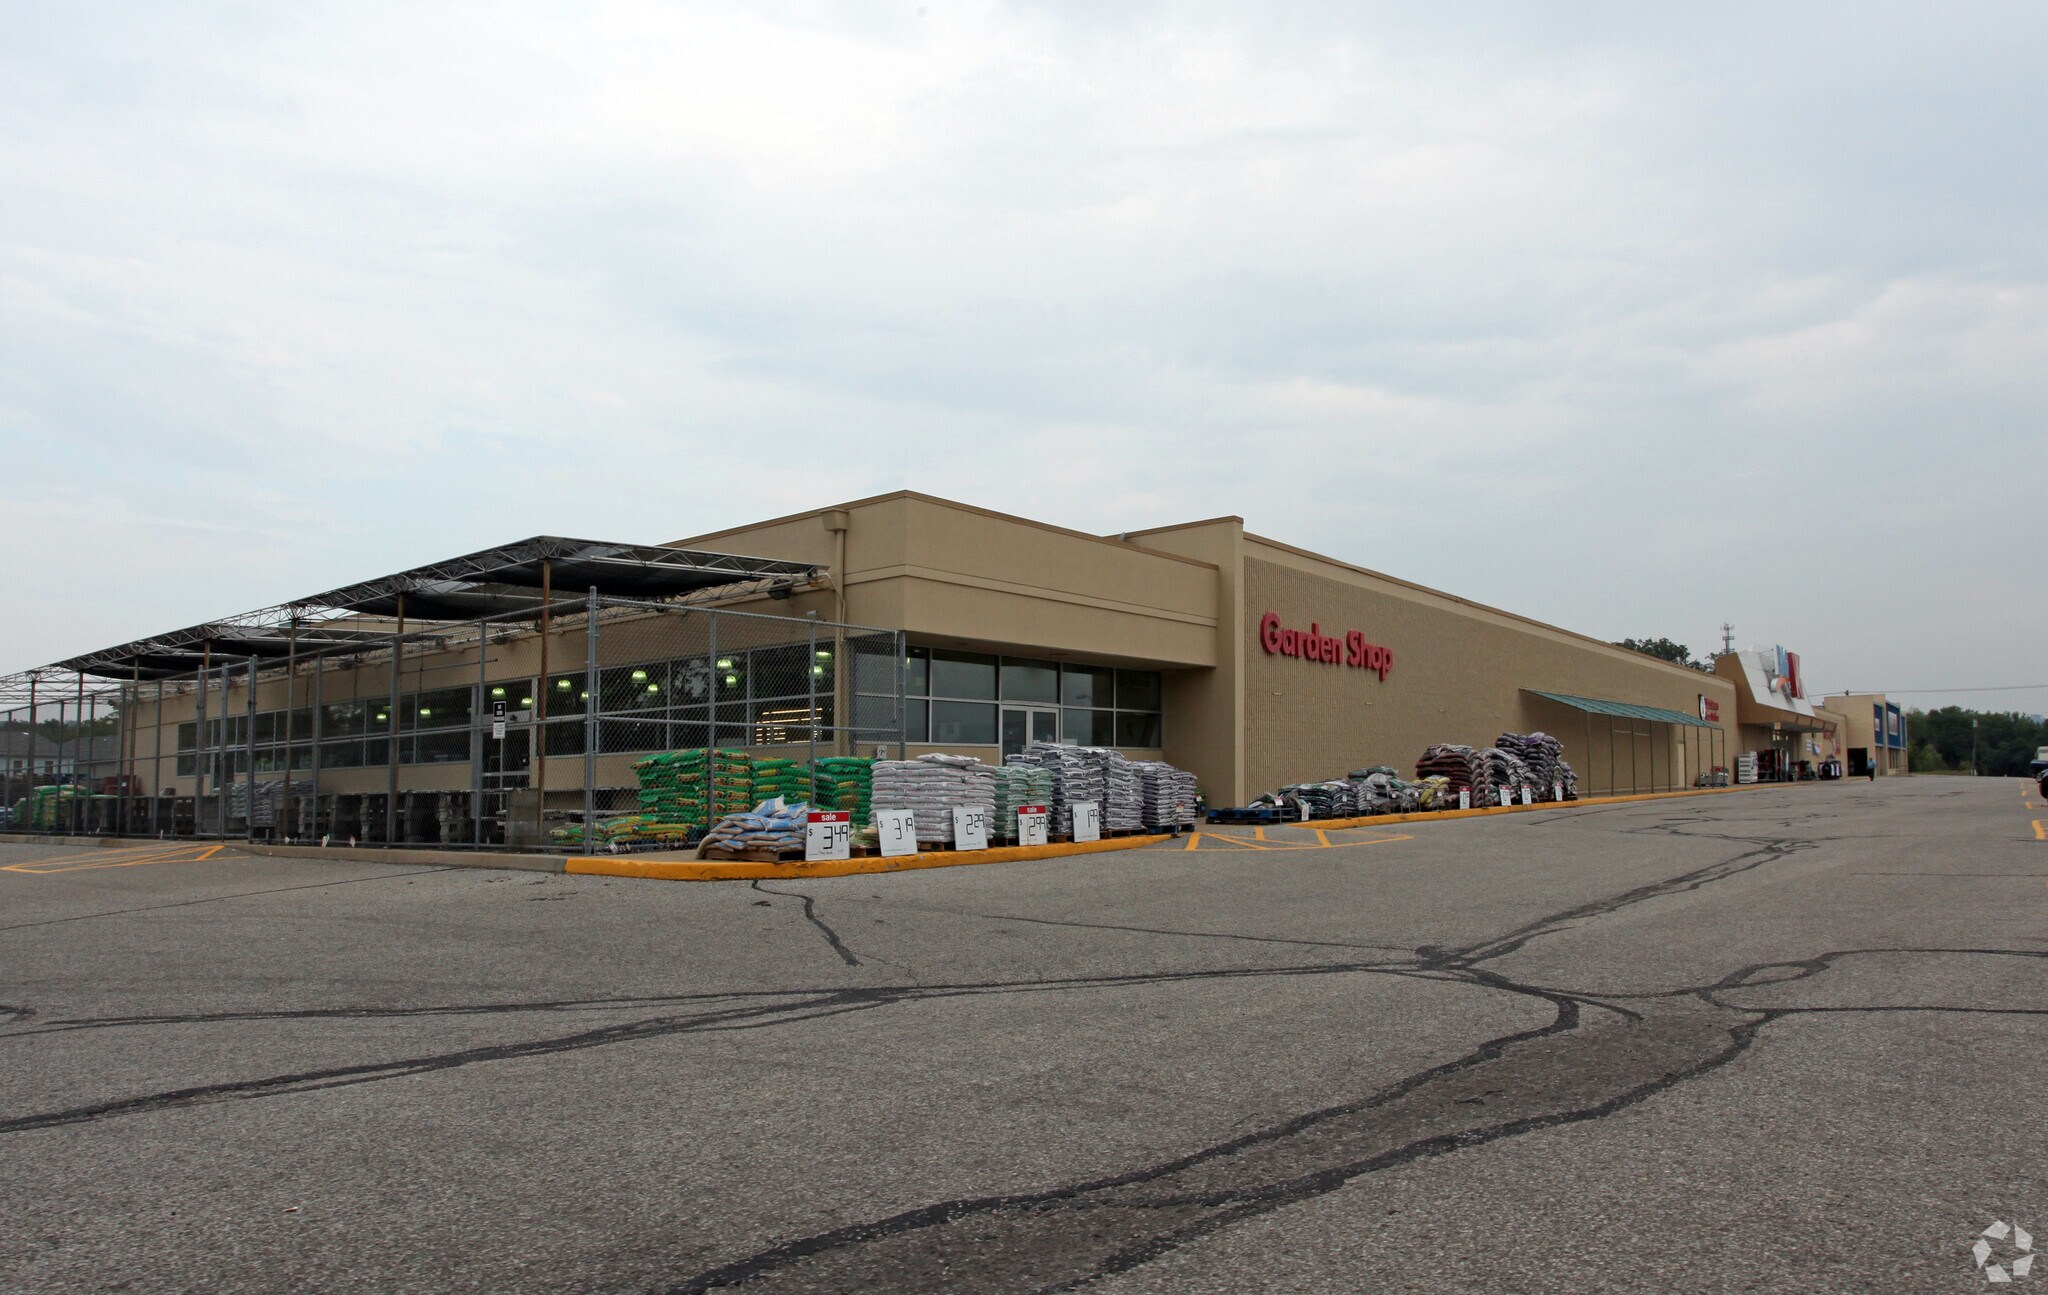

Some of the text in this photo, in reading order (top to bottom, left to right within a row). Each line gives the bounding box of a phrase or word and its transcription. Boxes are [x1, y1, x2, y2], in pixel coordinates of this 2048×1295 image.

[1261, 612, 1393, 681] Garden Shop
[821, 812, 837, 822] sale
